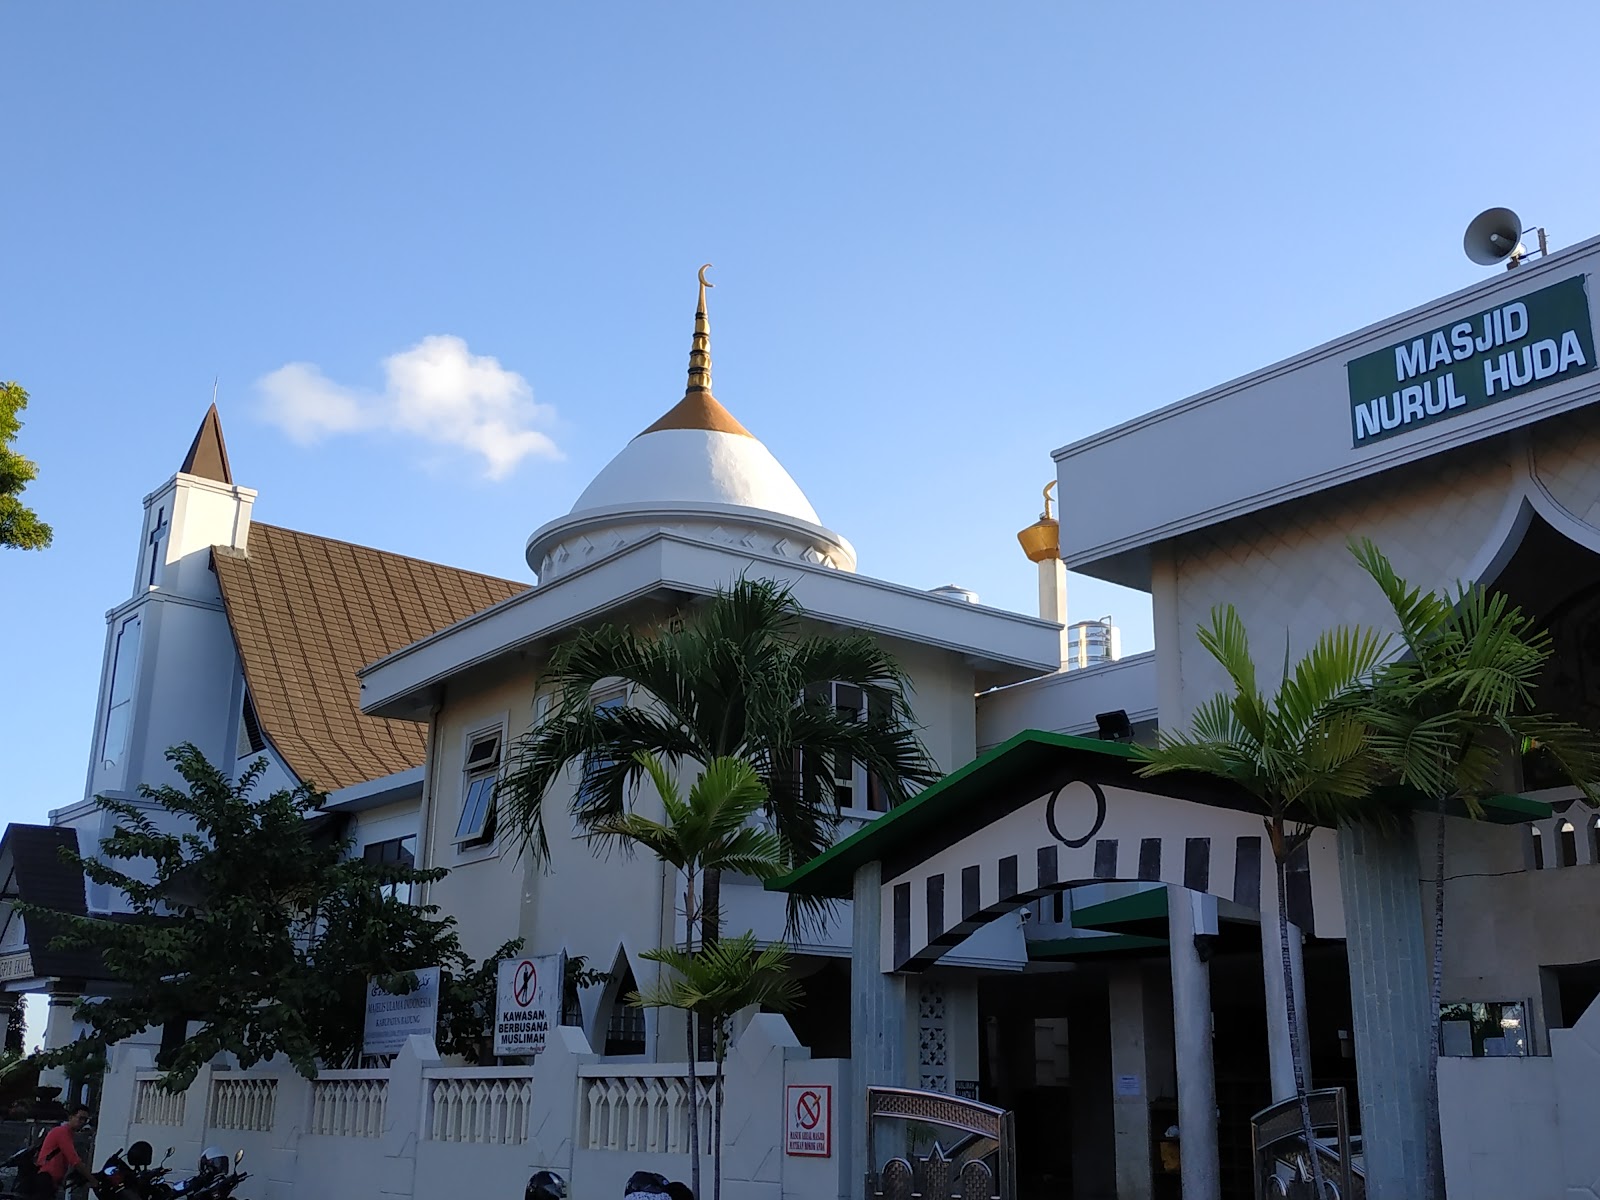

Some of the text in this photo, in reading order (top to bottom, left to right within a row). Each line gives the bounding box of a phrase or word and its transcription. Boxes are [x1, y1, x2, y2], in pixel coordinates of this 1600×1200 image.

[1394, 302, 1529, 381] MASJID
[1354, 330, 1586, 440] NURUL HUDA
[404, 997, 432, 1010] INDONESIA
[503, 1009, 545, 1022] KAWASAN
[498, 1021, 548, 1033] BERBUSANA
[501, 1033, 545, 1044] MUSLIMAH
